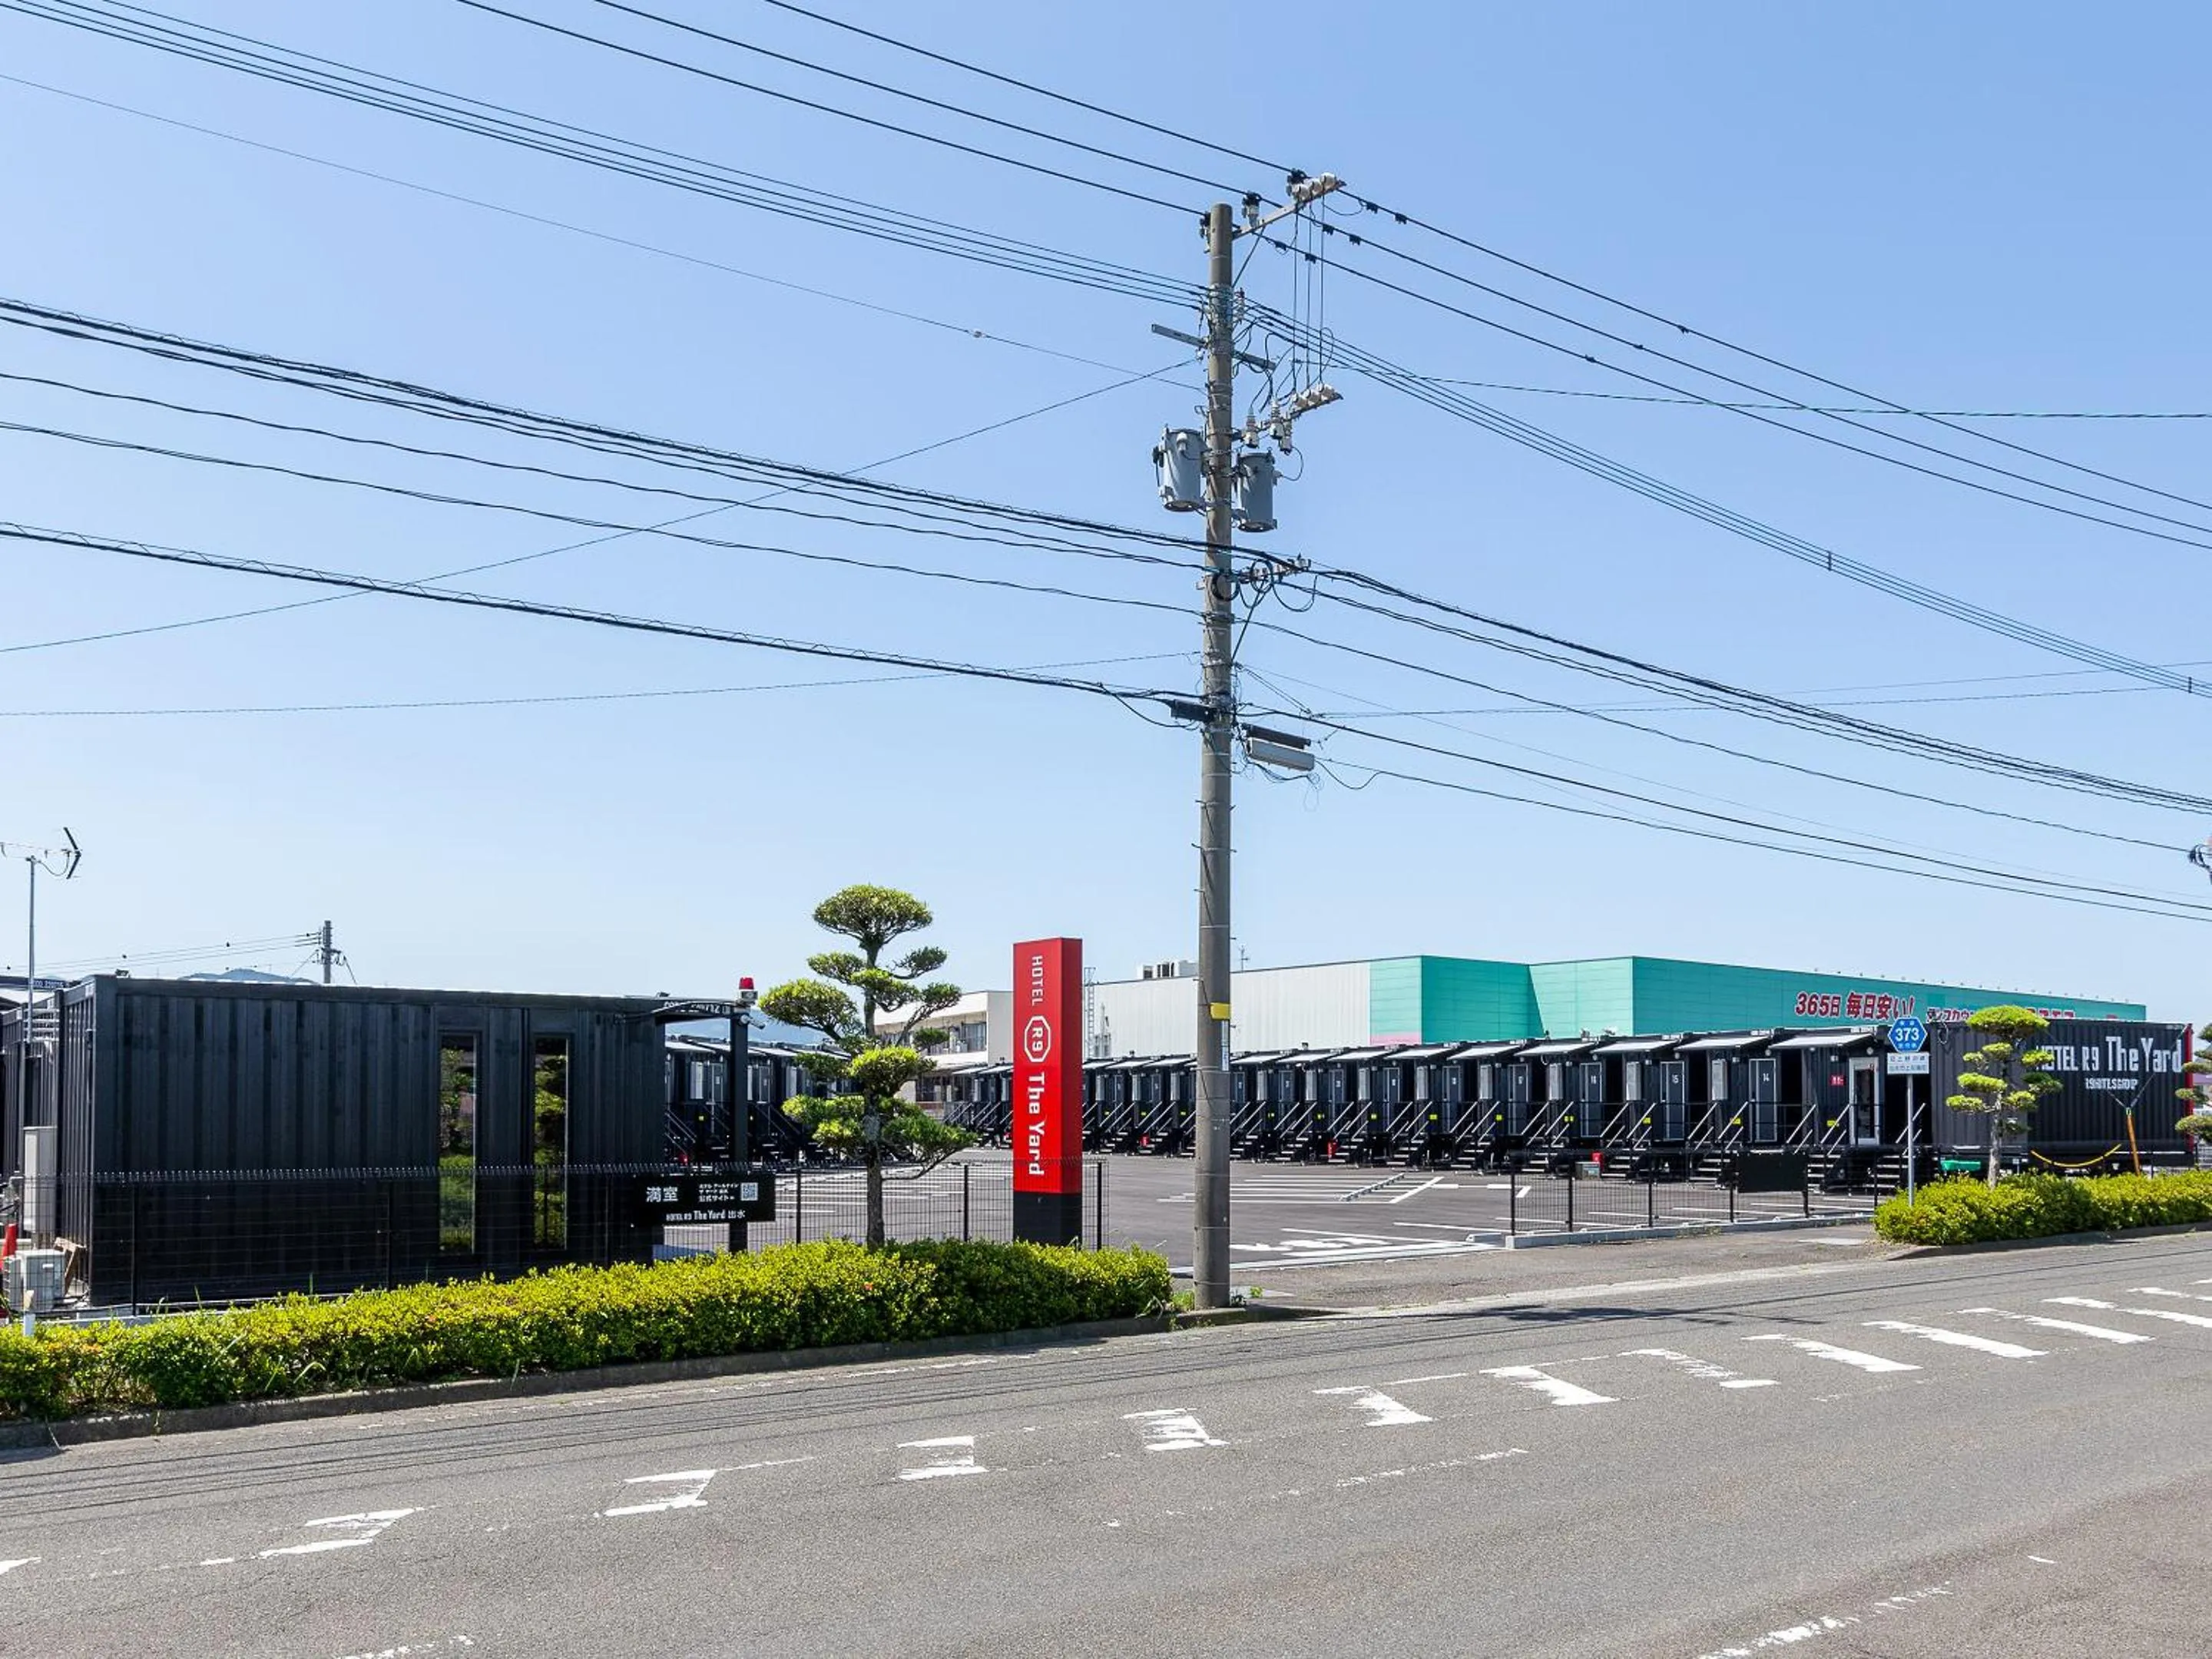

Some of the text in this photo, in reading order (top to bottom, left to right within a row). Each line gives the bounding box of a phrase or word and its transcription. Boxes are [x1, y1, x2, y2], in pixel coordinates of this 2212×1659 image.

[1795, 990, 1841, 1018] 365日
[1895, 1027, 1919, 1041] 373
[1028, 955, 1045, 1175] HOTEL R9 The Yard
[2082, 1047, 2100, 1071] R9
[2105, 1036, 2140, 1071] The
[2141, 1038, 2182, 1073] Yard
[646, 1186, 678, 1203] 満室
[694, 1210, 707, 1220] The
[707, 1209, 726, 1219] Yard
